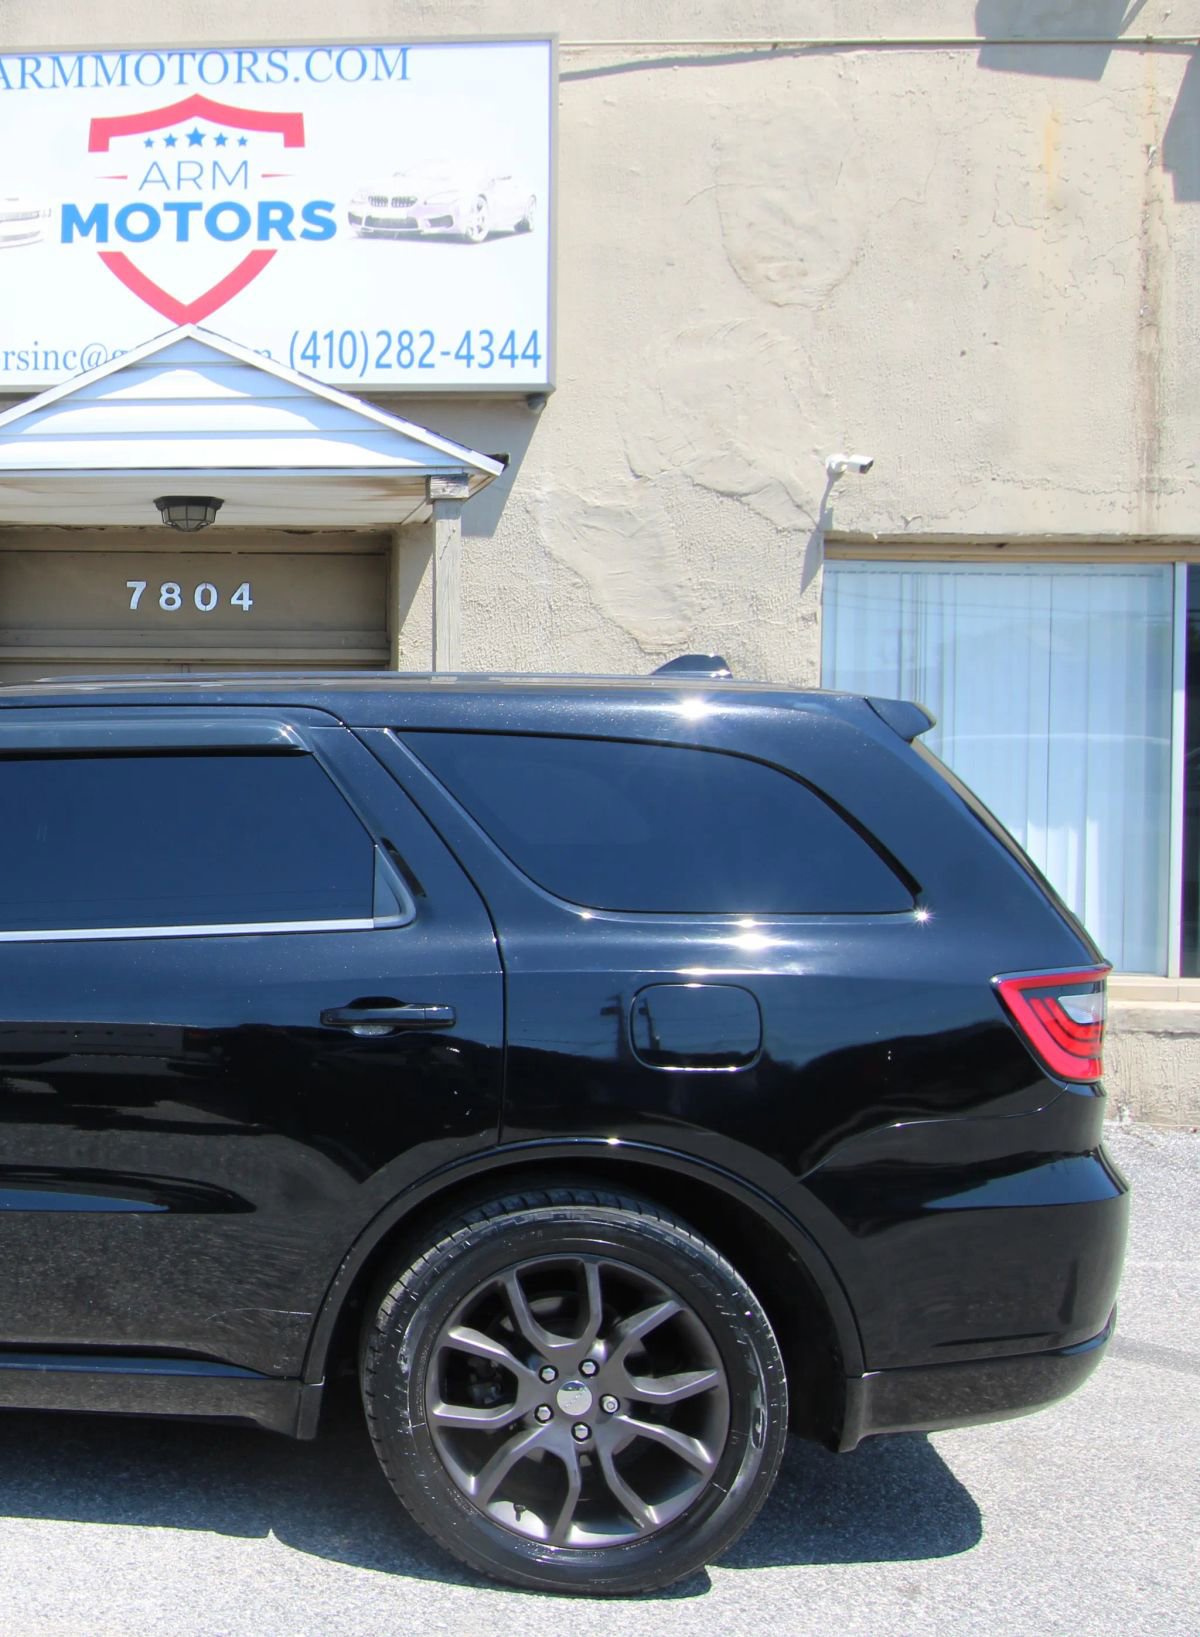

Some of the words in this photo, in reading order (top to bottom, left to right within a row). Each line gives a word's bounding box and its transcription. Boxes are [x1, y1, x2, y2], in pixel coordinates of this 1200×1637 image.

[138, 160, 249, 191] ARM
[61, 200, 338, 244] MOTORS
[289, 328, 542, 378] (410)282-4344
[126, 581, 253, 612] 7804
